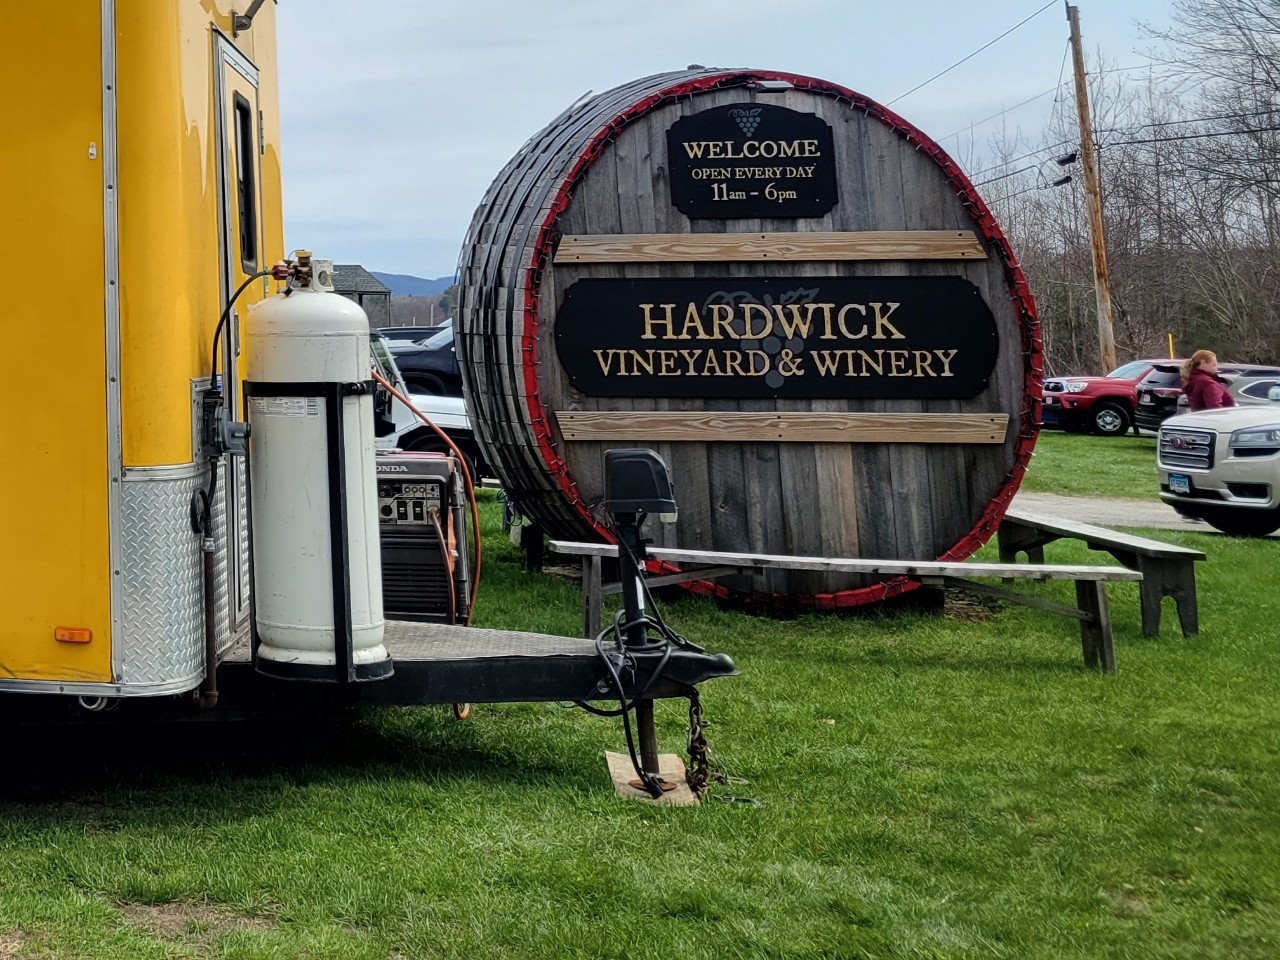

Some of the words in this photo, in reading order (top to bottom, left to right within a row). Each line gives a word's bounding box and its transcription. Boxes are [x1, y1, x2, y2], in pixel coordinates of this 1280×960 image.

[682, 140, 821, 159] WELCOME
[692, 168, 732, 180] OPEN
[734, 167, 782, 180] EVERY
[785, 166, 814, 179] DAY
[710, 184, 746, 201] 11am
[764, 183, 797, 202] 6pm
[639, 302, 906, 340] HARDWICK
[593, 349, 770, 376] VINEYARD
[778, 348, 804, 377] &
[810, 349, 958, 377] WINERY
